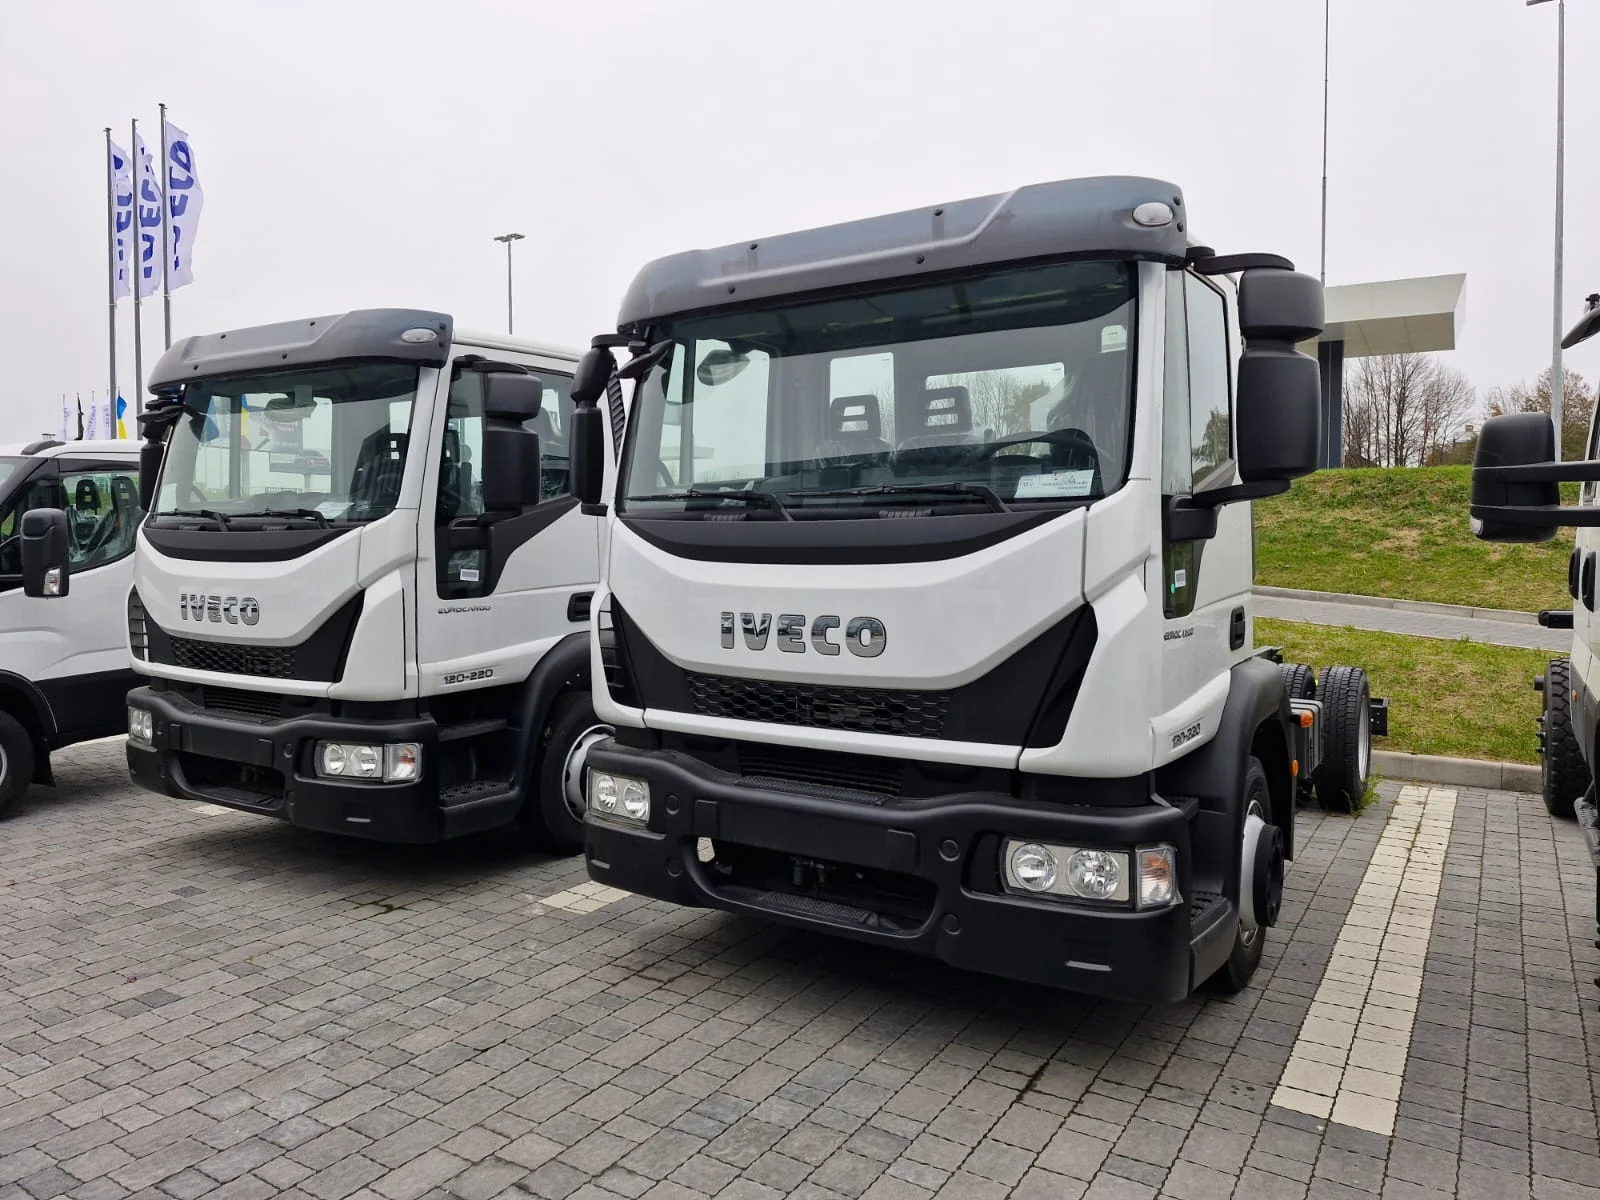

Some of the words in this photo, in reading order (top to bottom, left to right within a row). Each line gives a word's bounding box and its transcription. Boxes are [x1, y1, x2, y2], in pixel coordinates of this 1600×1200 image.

[139, 147, 161, 278] IVEC
[180, 593, 260, 626] IVECO
[720, 611, 887, 658] IVECO
[443, 669, 494, 685] 120-220
